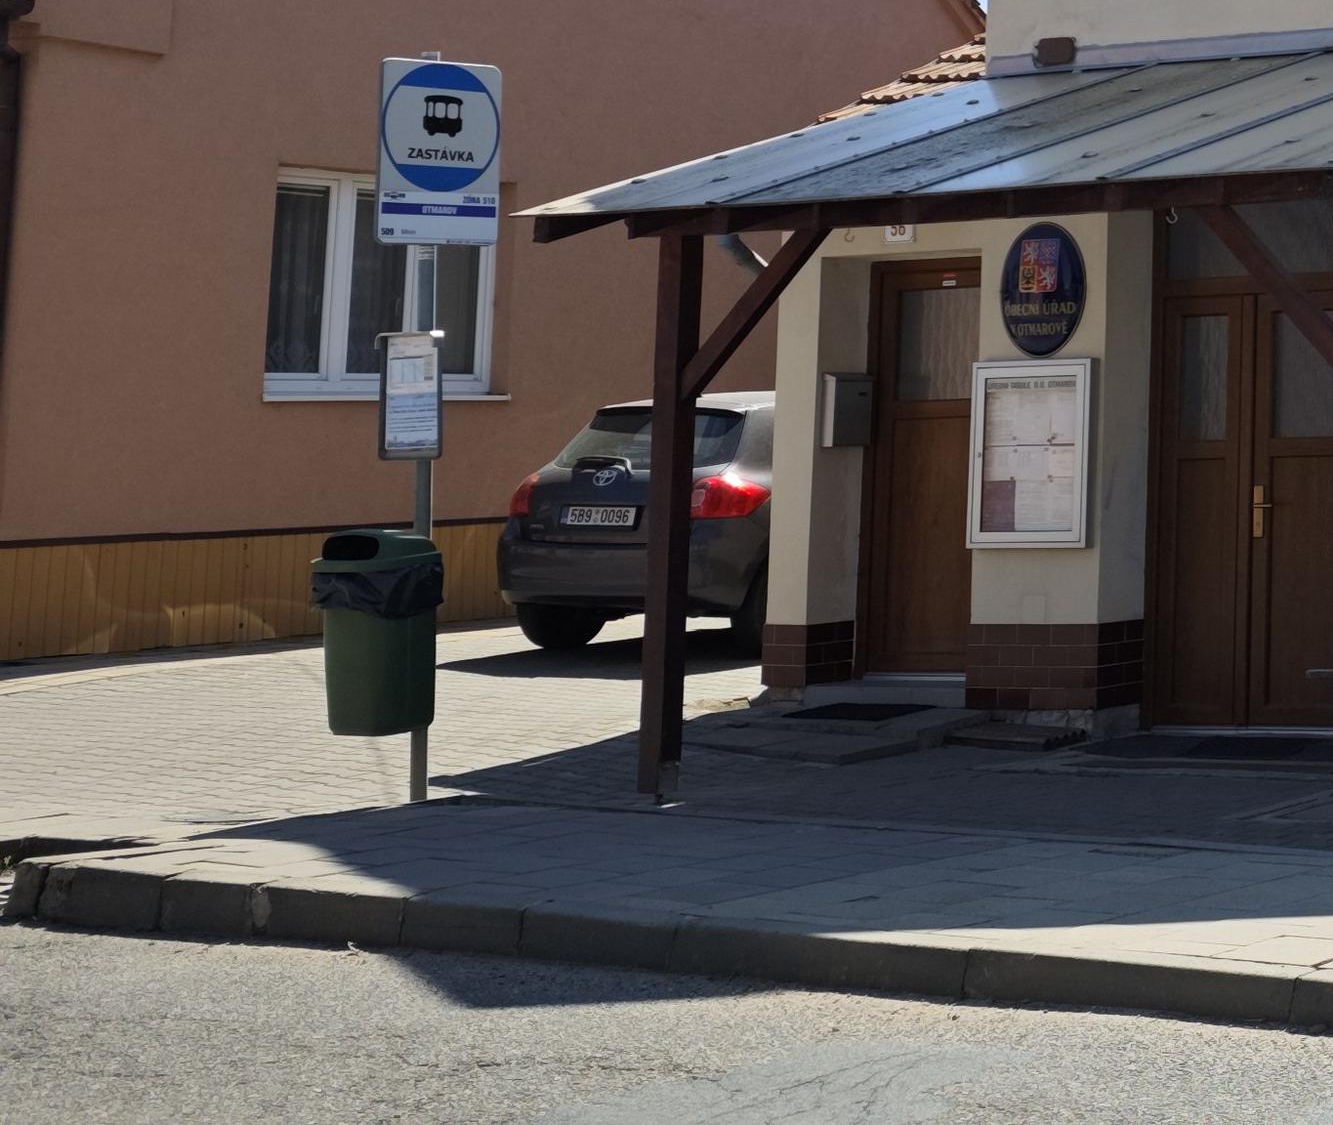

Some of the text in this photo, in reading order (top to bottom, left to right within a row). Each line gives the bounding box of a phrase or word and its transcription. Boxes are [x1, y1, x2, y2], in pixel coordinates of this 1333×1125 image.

[407, 146, 474, 162] ZASTÁVKA
[381, 227, 395, 236] 509
[570, 508, 630, 524] 5B9 0096
